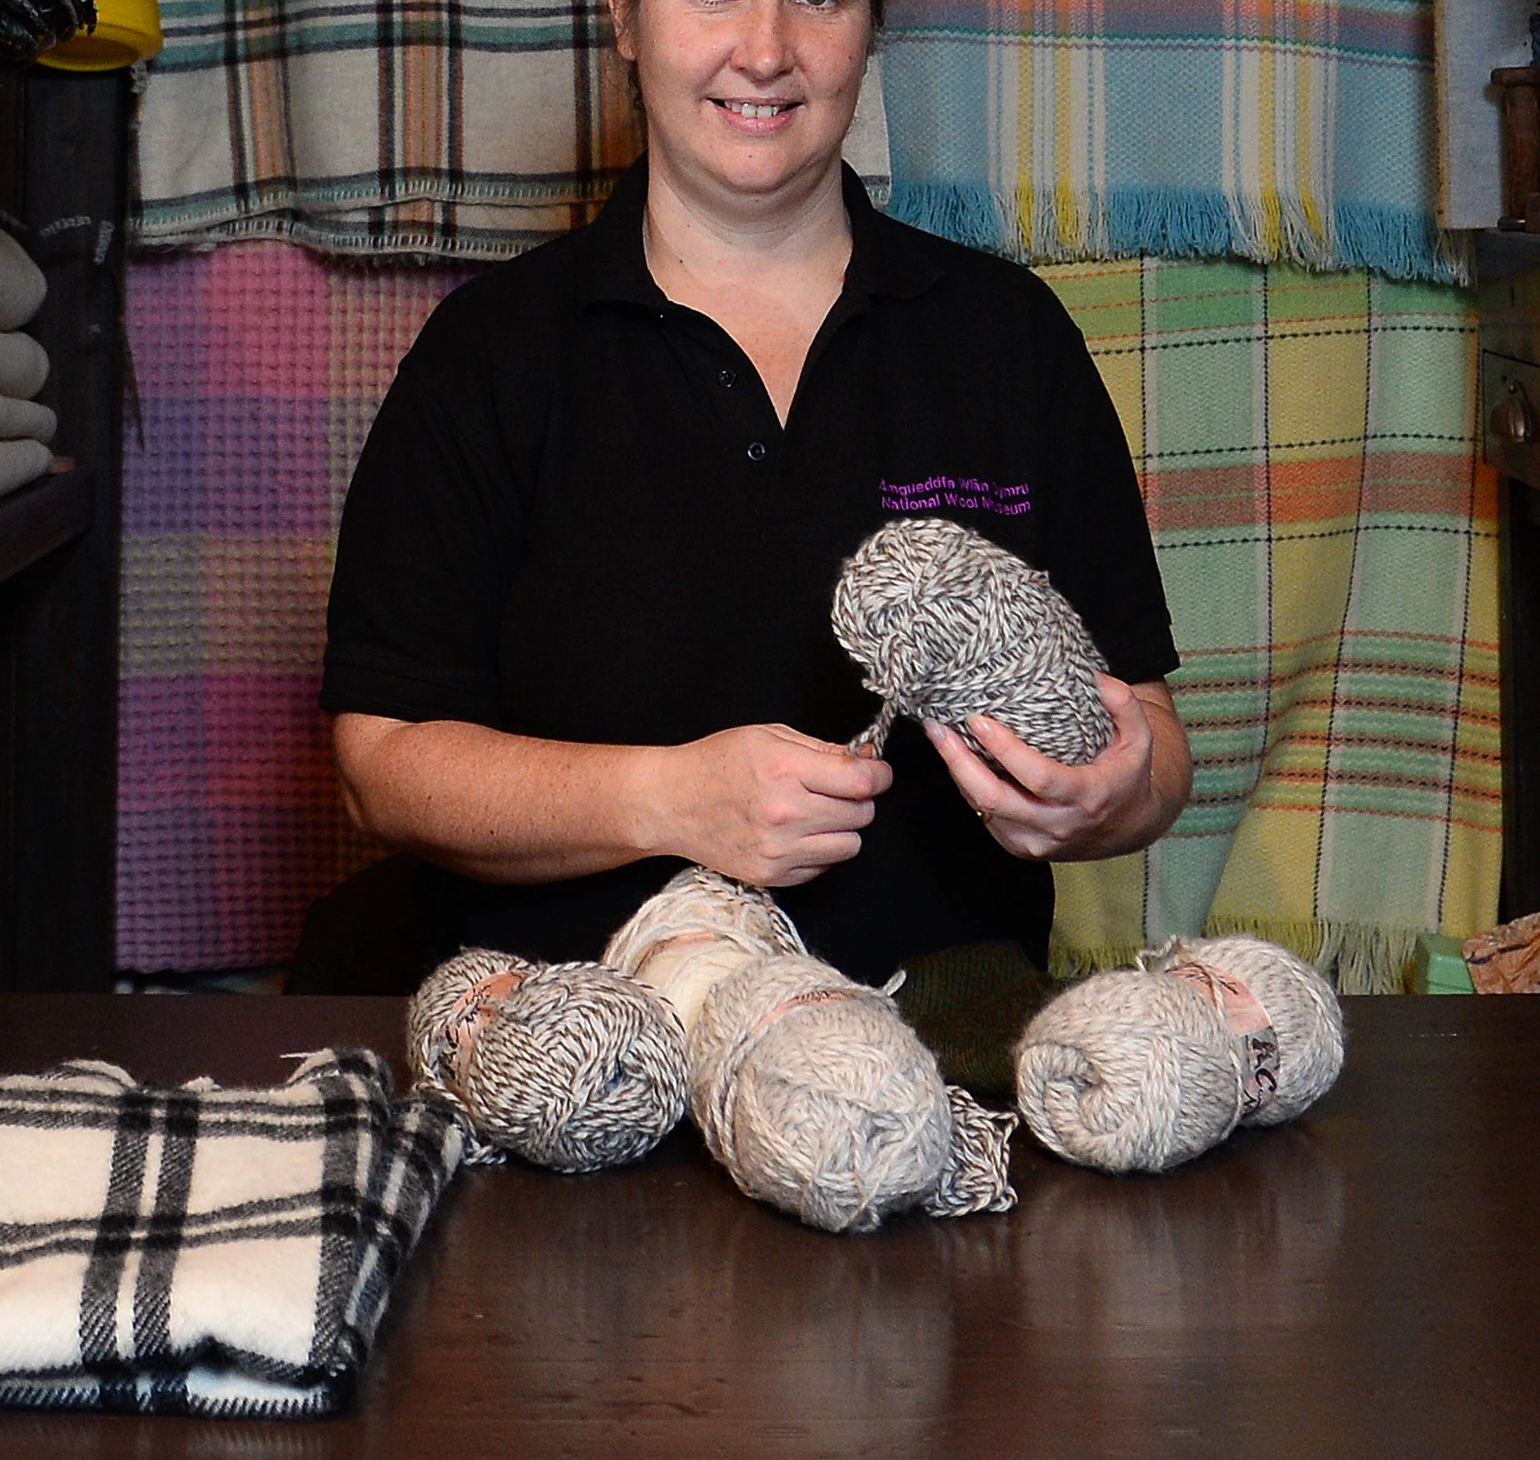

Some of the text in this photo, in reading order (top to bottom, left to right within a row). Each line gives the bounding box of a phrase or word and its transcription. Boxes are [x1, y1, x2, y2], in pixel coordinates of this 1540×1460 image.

[878, 475, 956, 497] Amgueddfa
[880, 493, 941, 512] National
[944, 492, 979, 510] Wool
